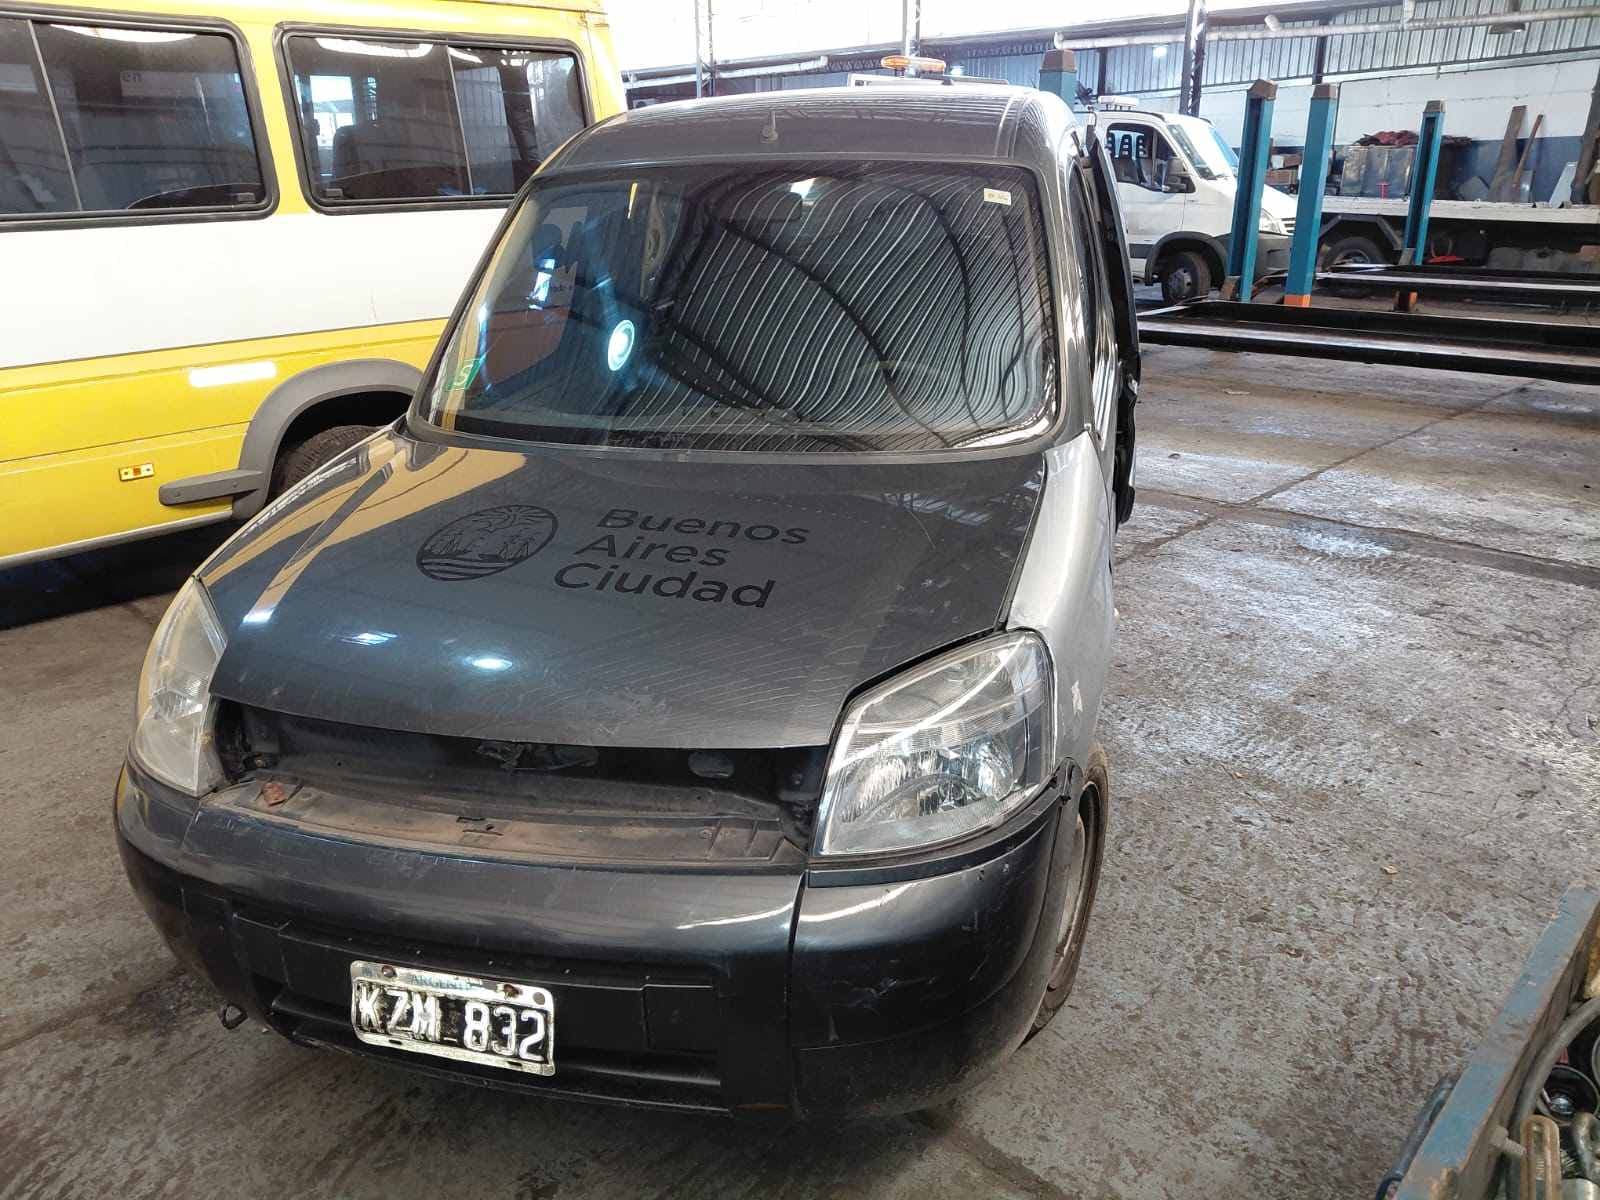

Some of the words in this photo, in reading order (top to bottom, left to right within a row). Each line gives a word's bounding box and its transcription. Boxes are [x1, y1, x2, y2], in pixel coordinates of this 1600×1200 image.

[597, 508, 809, 544] Buenos
[574, 534, 731, 566] Aires
[554, 562, 776, 608] Ciudad
[357, 982, 440, 1042] KZM
[463, 1000, 546, 1061] 832
